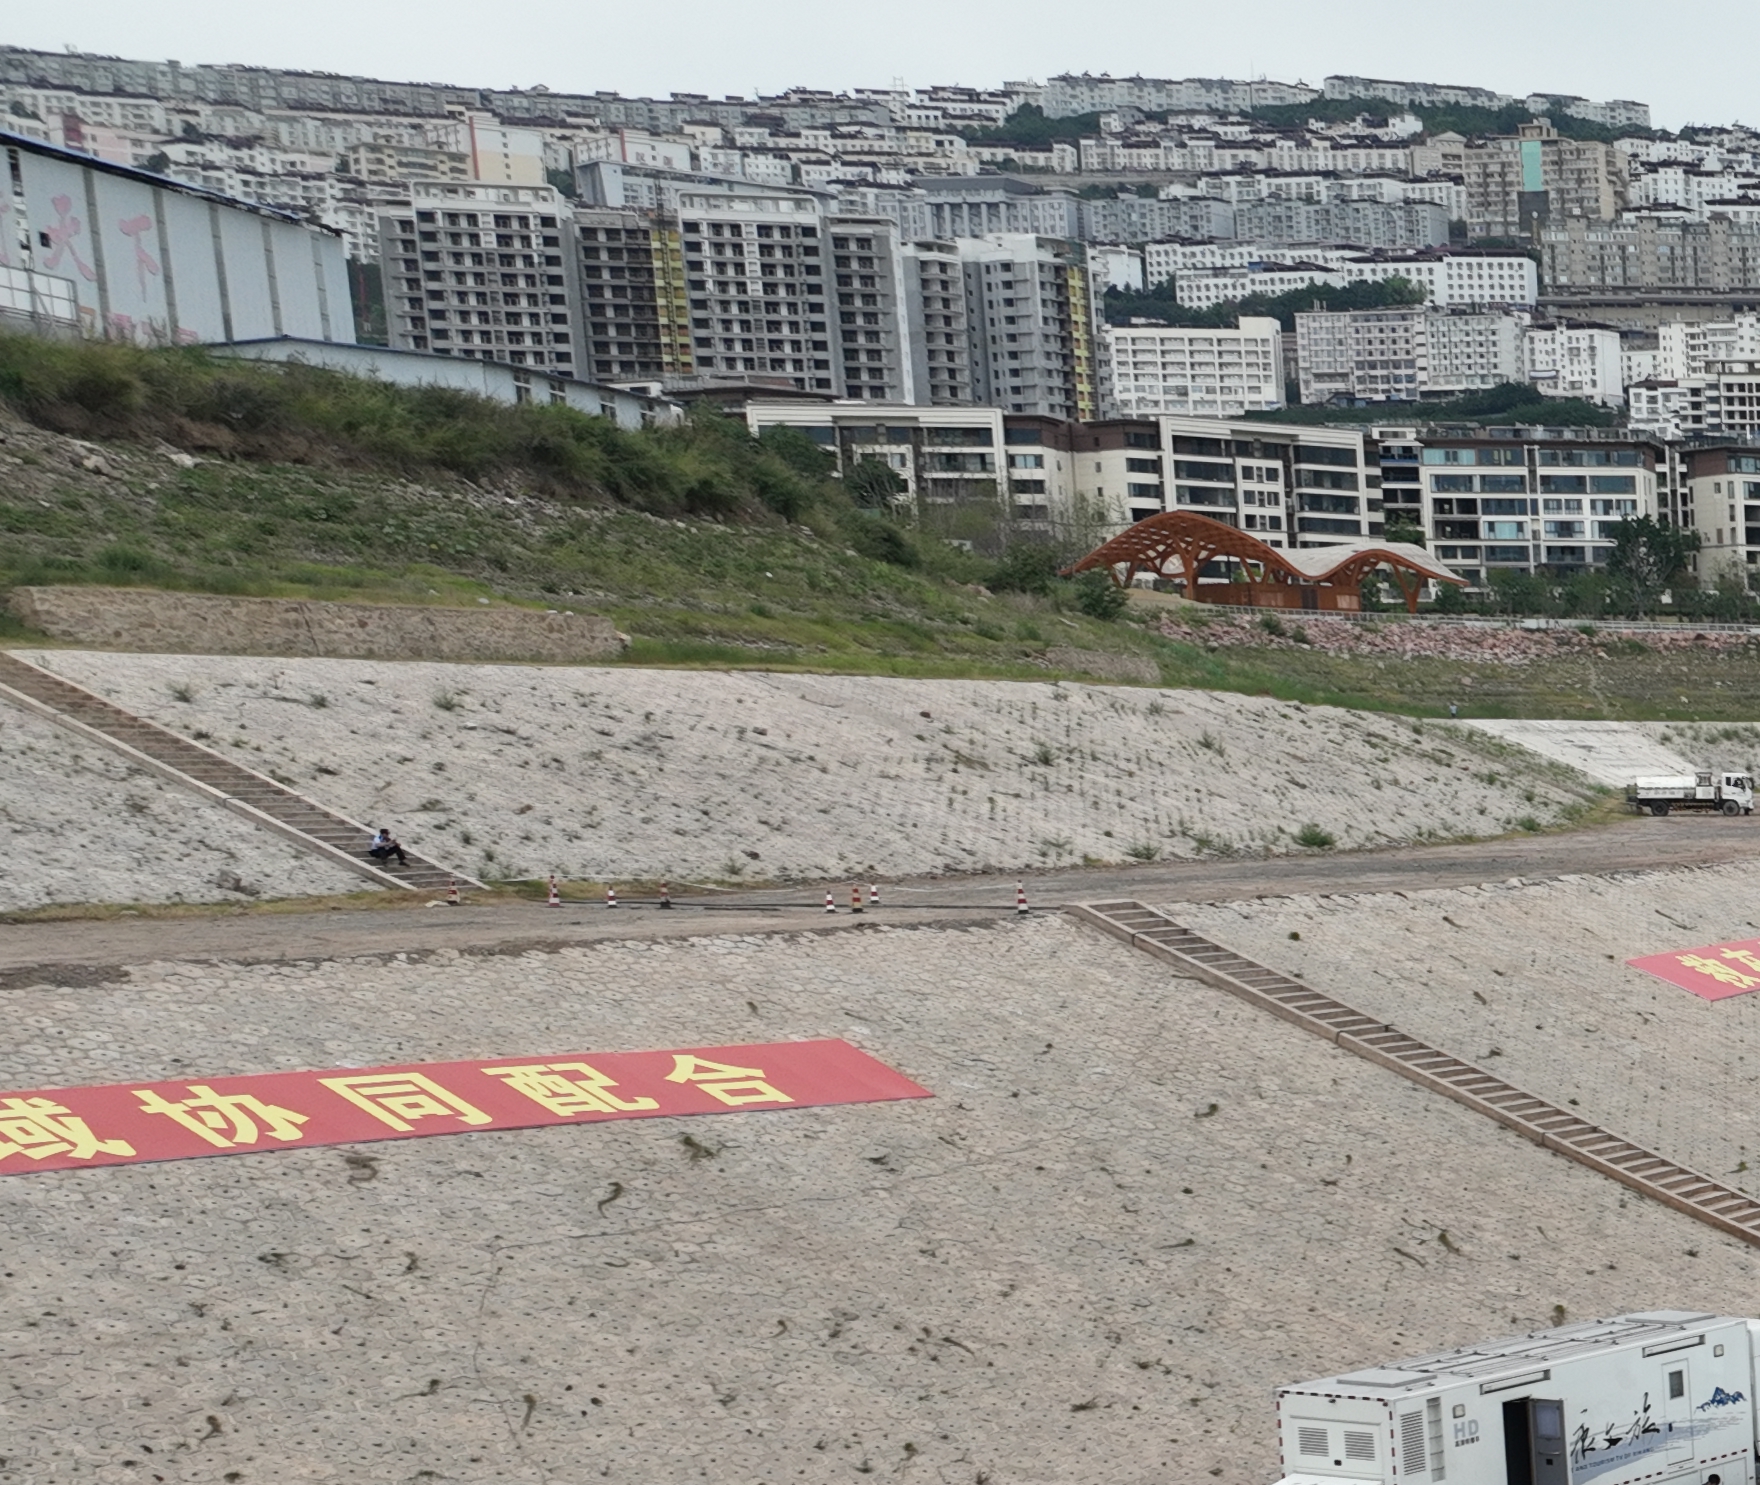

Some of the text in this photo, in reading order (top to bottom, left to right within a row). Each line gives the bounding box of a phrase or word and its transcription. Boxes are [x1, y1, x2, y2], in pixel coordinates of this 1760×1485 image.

[0, 1053, 794, 1161] 域协同配合
[1453, 1419, 1480, 1440] HD
